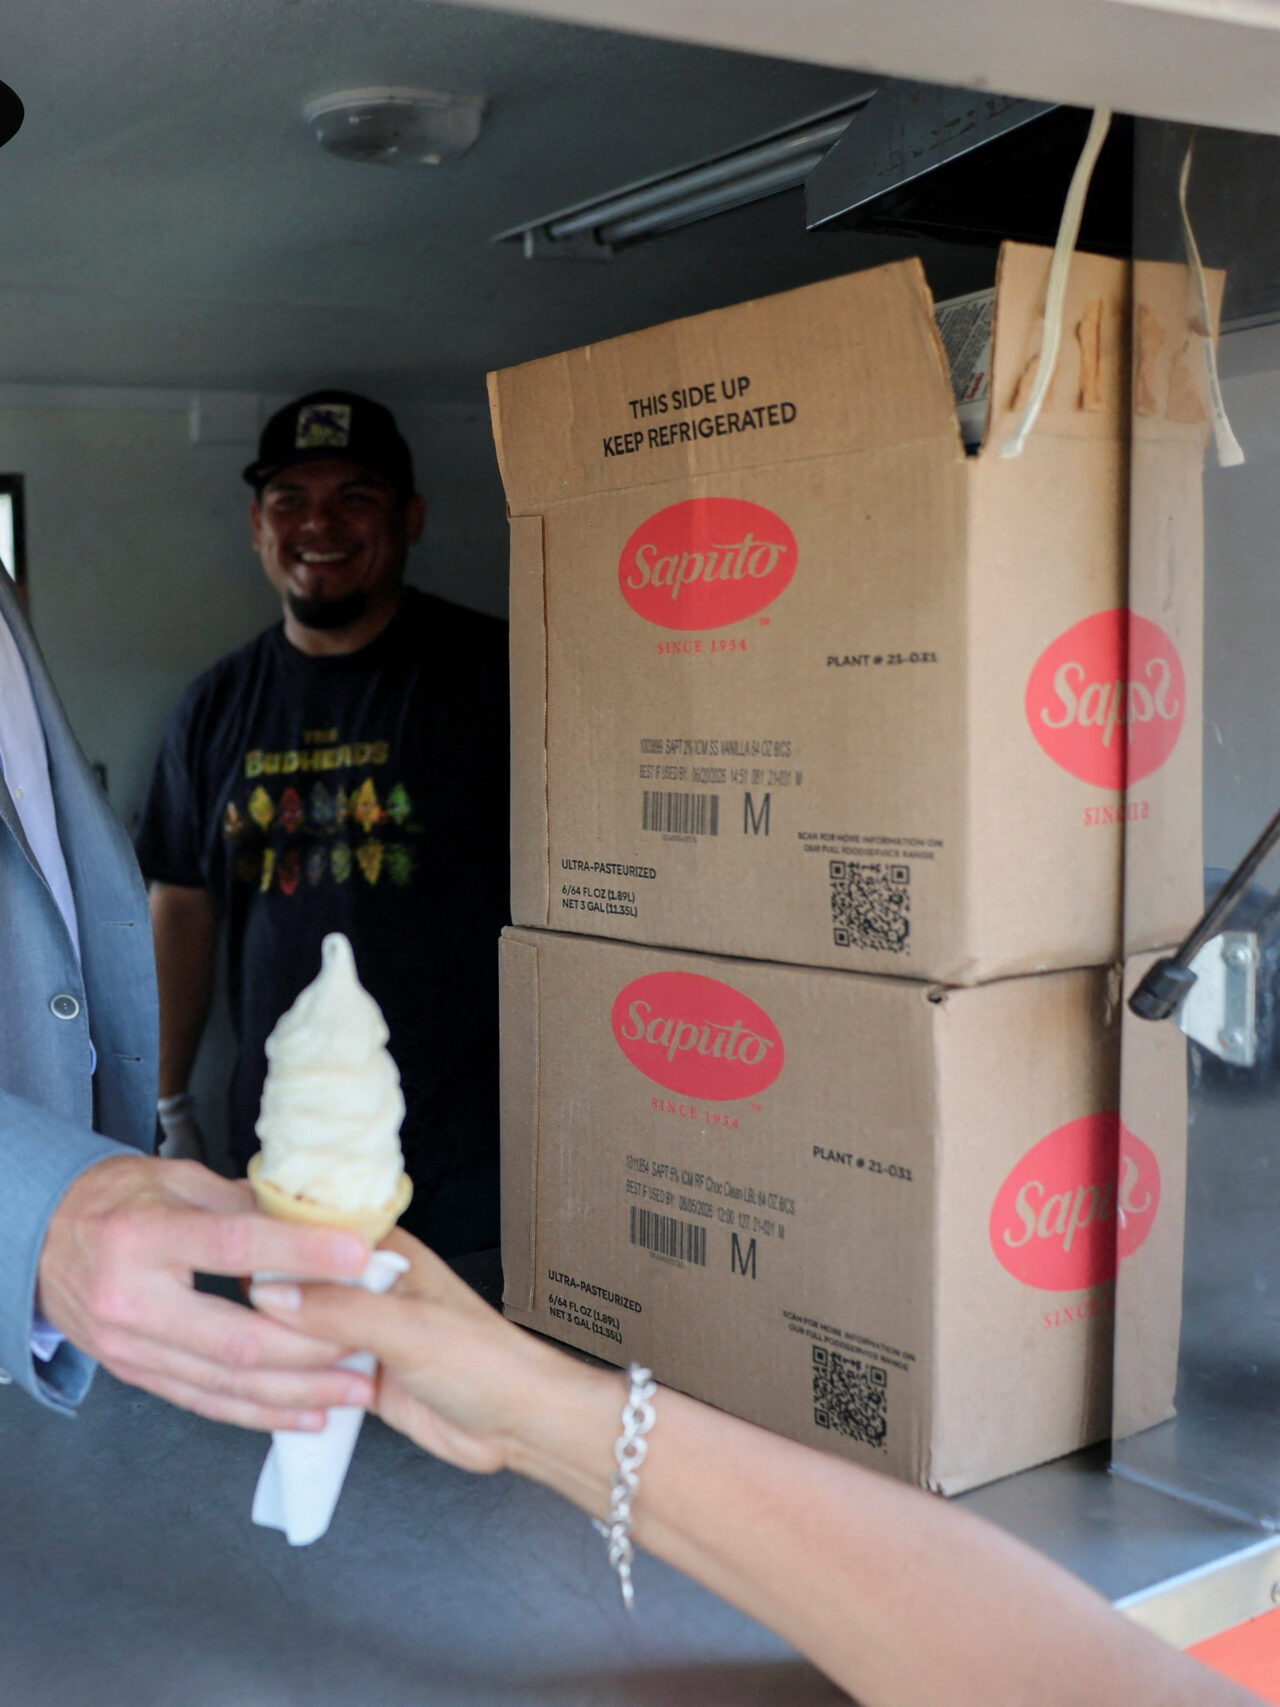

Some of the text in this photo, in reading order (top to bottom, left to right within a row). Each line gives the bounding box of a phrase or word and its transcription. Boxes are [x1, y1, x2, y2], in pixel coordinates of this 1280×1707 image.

[628, 375, 751, 419] THIS SIDE UP
[602, 401, 797, 457] KEEP REFRIGERATED
[627, 532, 787, 601] Saputo
[656, 638, 748, 656] SINCE 1954
[826, 654, 870, 668] PLANT
[744, 791, 771, 837] M
[797, 832, 818, 841] SCAN
[820, 832, 835, 842] FOR
[862, 835, 925, 847] INFORMATION
[561, 858, 657, 879] ULTRA-PASTEURIZED
[561, 884, 581, 896] 6/64
[583, 887, 592, 898] FL
[593, 888, 607, 899] OZ
[562, 898, 638, 918] NET 3 GAL (11.35L)
[621, 999, 775, 1065] Saputo
[651, 1097, 740, 1129] SINCE 1954
[813, 1145, 854, 1166] PLANT
[868, 1159, 913, 1182] 21-031
[626, 1179, 642, 1196] BEST
[731, 1231, 756, 1280] M
[548, 1269, 642, 1313] ULTRA-PASTEURIZED
[548, 1294, 568, 1309] 6/64
[569, 1301, 579, 1313] FL
[580, 1305, 592, 1318] OZ
[549, 1306, 623, 1345] NET 3 GAL (11.35L)
[782, 1310, 803, 1324] SCAN
[804, 1317, 819, 1329] FOR
[844, 1331, 901, 1357] INFORMATION
[788, 1322, 805, 1336] OUR
[806, 1328, 823, 1342] FULL
